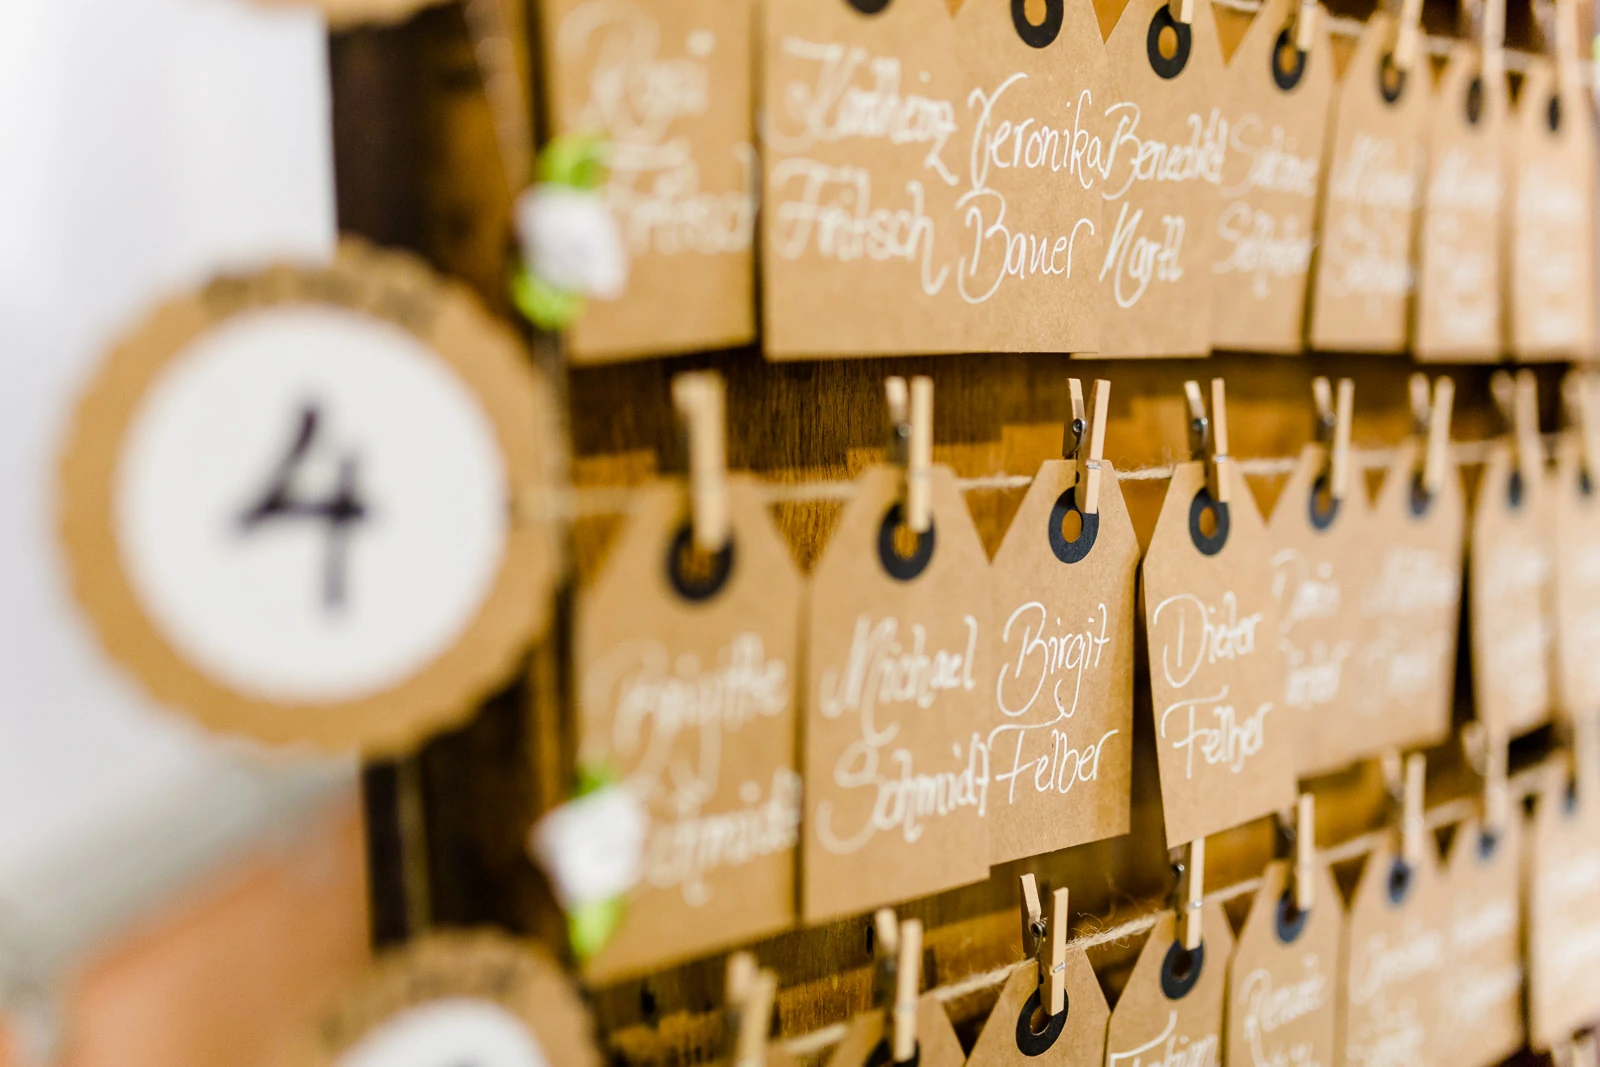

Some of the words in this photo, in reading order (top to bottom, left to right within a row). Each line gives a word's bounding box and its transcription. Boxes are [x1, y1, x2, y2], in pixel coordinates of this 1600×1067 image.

[967, 71, 1104, 190] Veronika
[767, 156, 950, 296] Fritsch
[954, 187, 1095, 305] Bauer
[228, 398, 372, 615] 4
[818, 612, 979, 747] Michael
[996, 601, 1110, 717] Birgit
[1153, 590, 1264, 689] Dieter
[814, 731, 991, 856] Schmidt
[987, 708, 1120, 804] Felber
